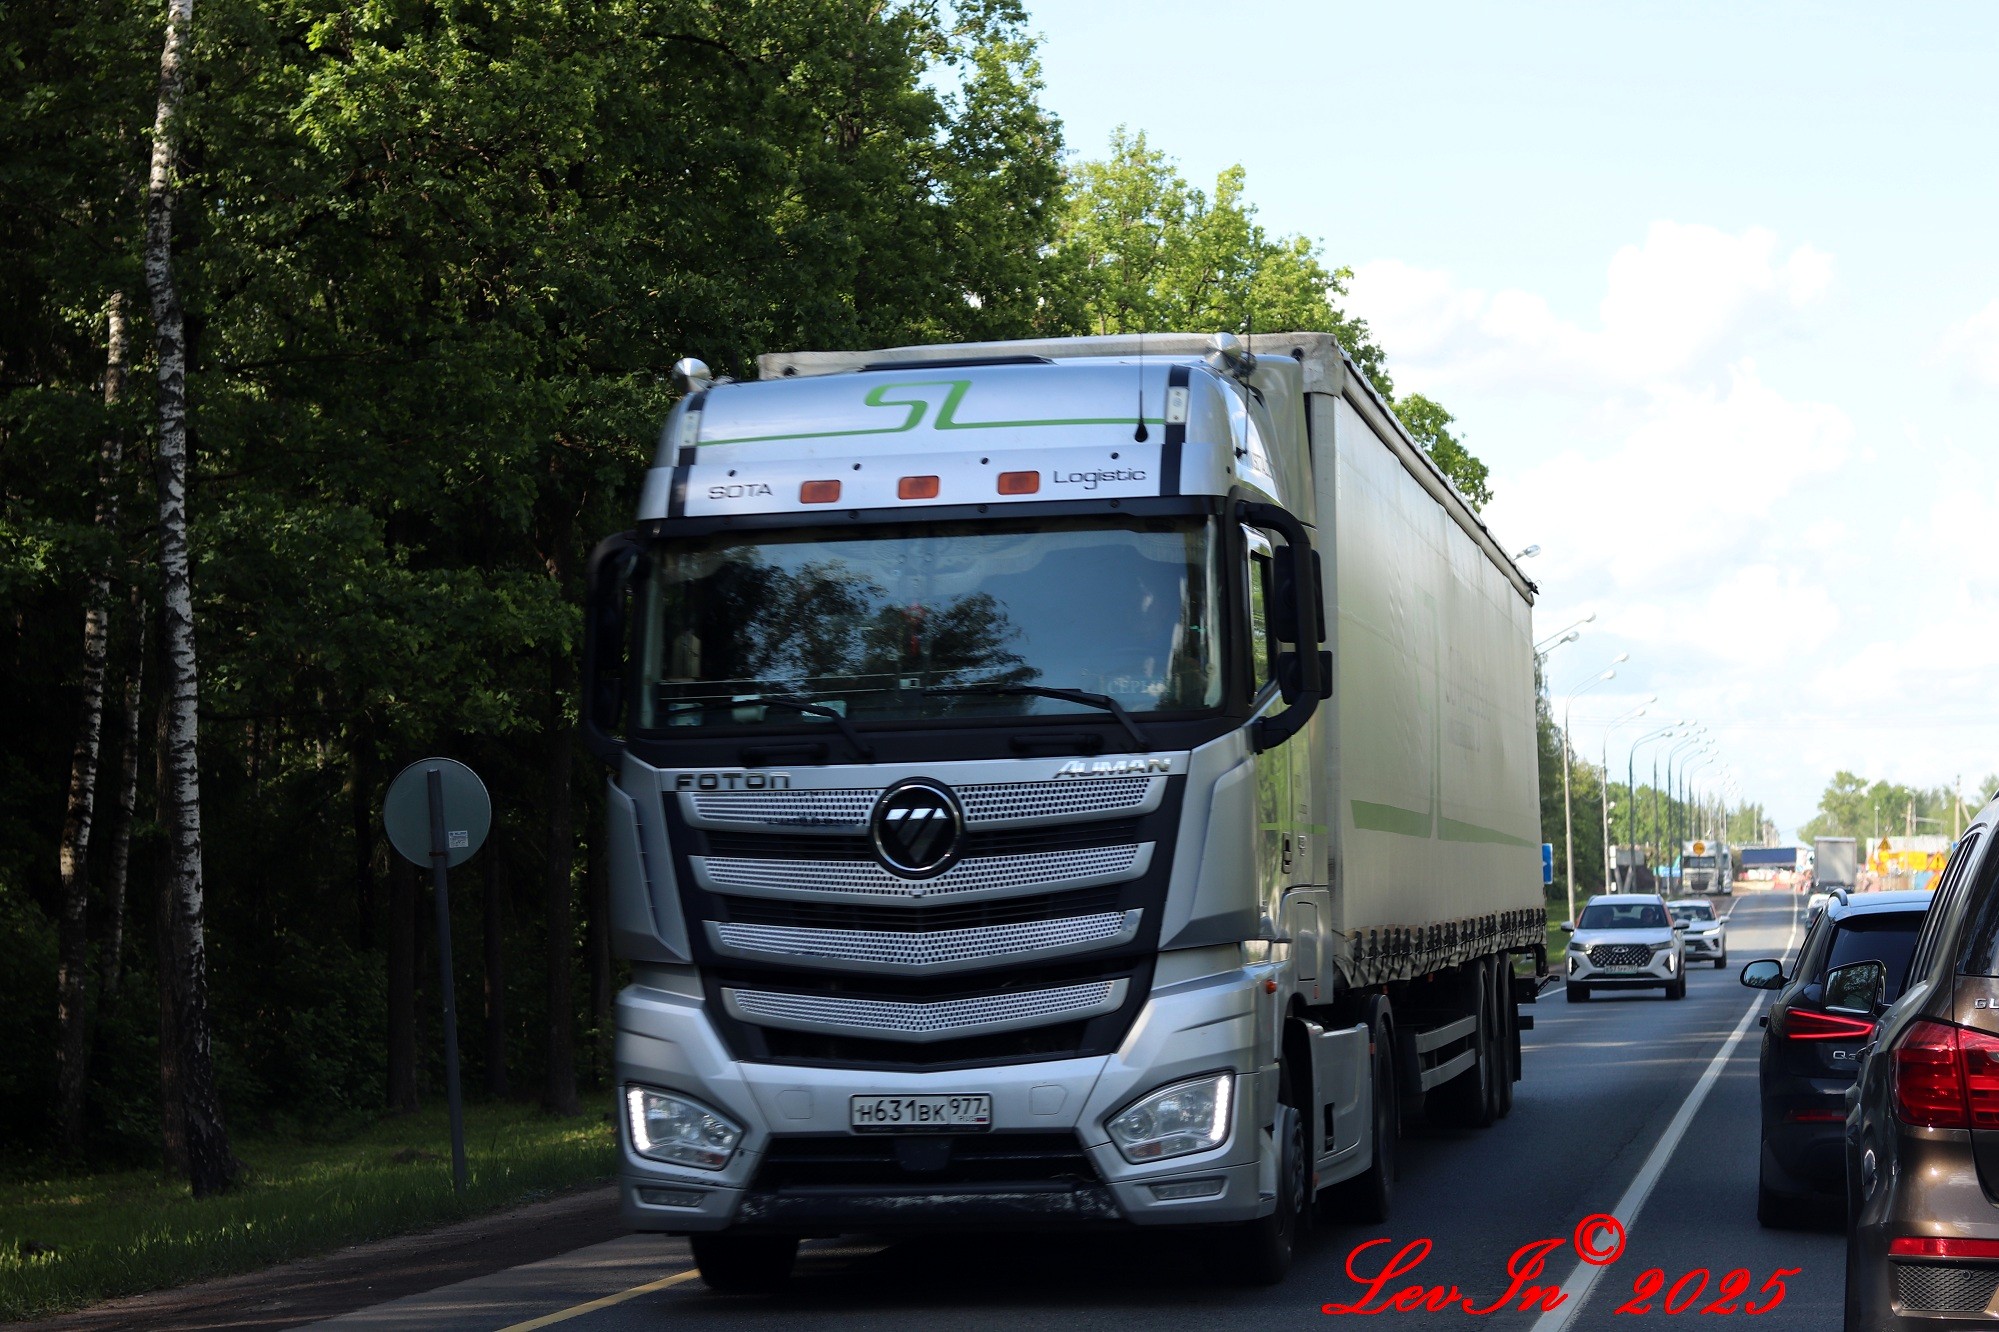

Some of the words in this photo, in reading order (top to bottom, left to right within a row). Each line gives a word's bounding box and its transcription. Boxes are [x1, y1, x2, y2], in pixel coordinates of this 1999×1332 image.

[708, 483, 773, 500] SOTA
[1053, 468, 1147, 490] Logistic
[1053, 758, 1172, 779] AUMAN
[859, 1099, 946, 1122] Н631ВК
[949, 1097, 983, 1115] 977
